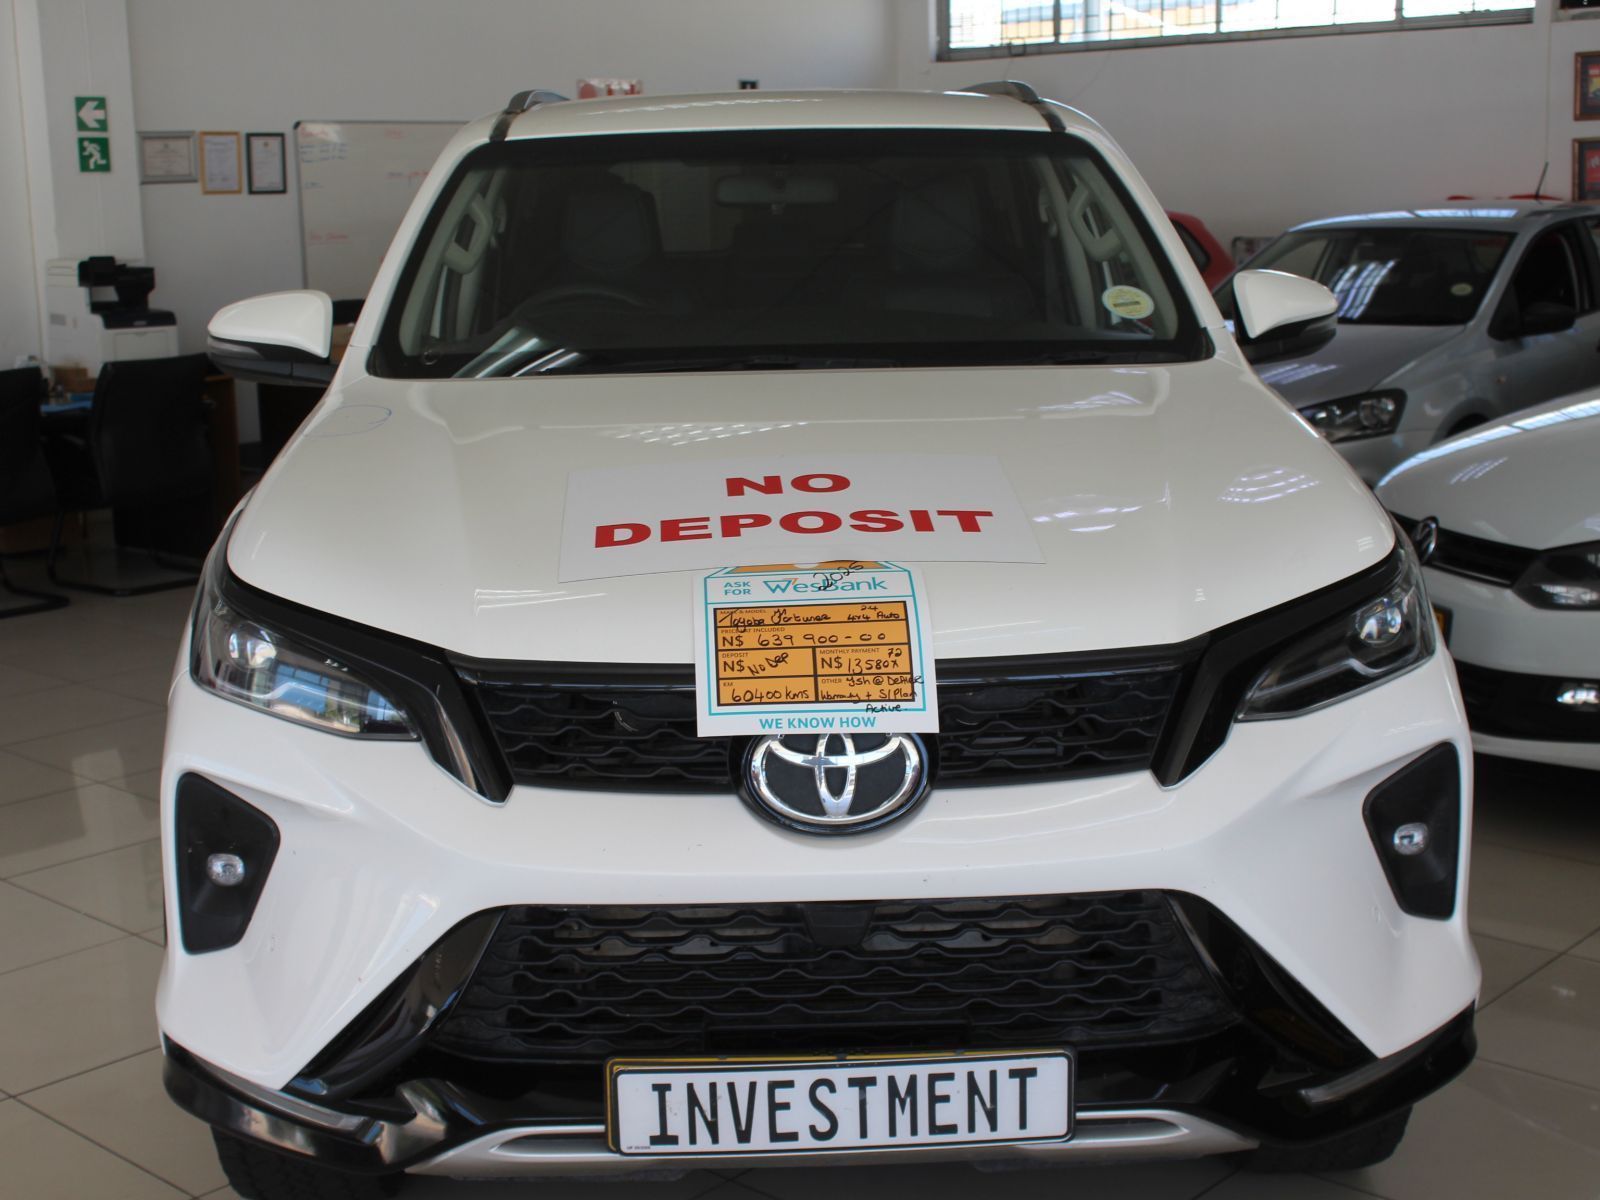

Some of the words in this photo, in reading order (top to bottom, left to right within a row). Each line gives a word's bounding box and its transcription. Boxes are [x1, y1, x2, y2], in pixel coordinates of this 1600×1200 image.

[726, 473, 851, 497] NO
[594, 509, 994, 548] DEPOSIT
[724, 588, 751, 596] FOR
[762, 577, 888, 594] WesBank
[722, 634, 745, 647] N$
[757, 633, 795, 647] 639
[723, 659, 745, 672] N$
[820, 656, 843, 670] N$
[731, 688, 782, 703] 60400
[760, 718, 784, 730] WE
[787, 717, 835, 729] KNOW
[839, 716, 877, 728] HOW
[648, 1067, 1038, 1147] INVESTMENT
